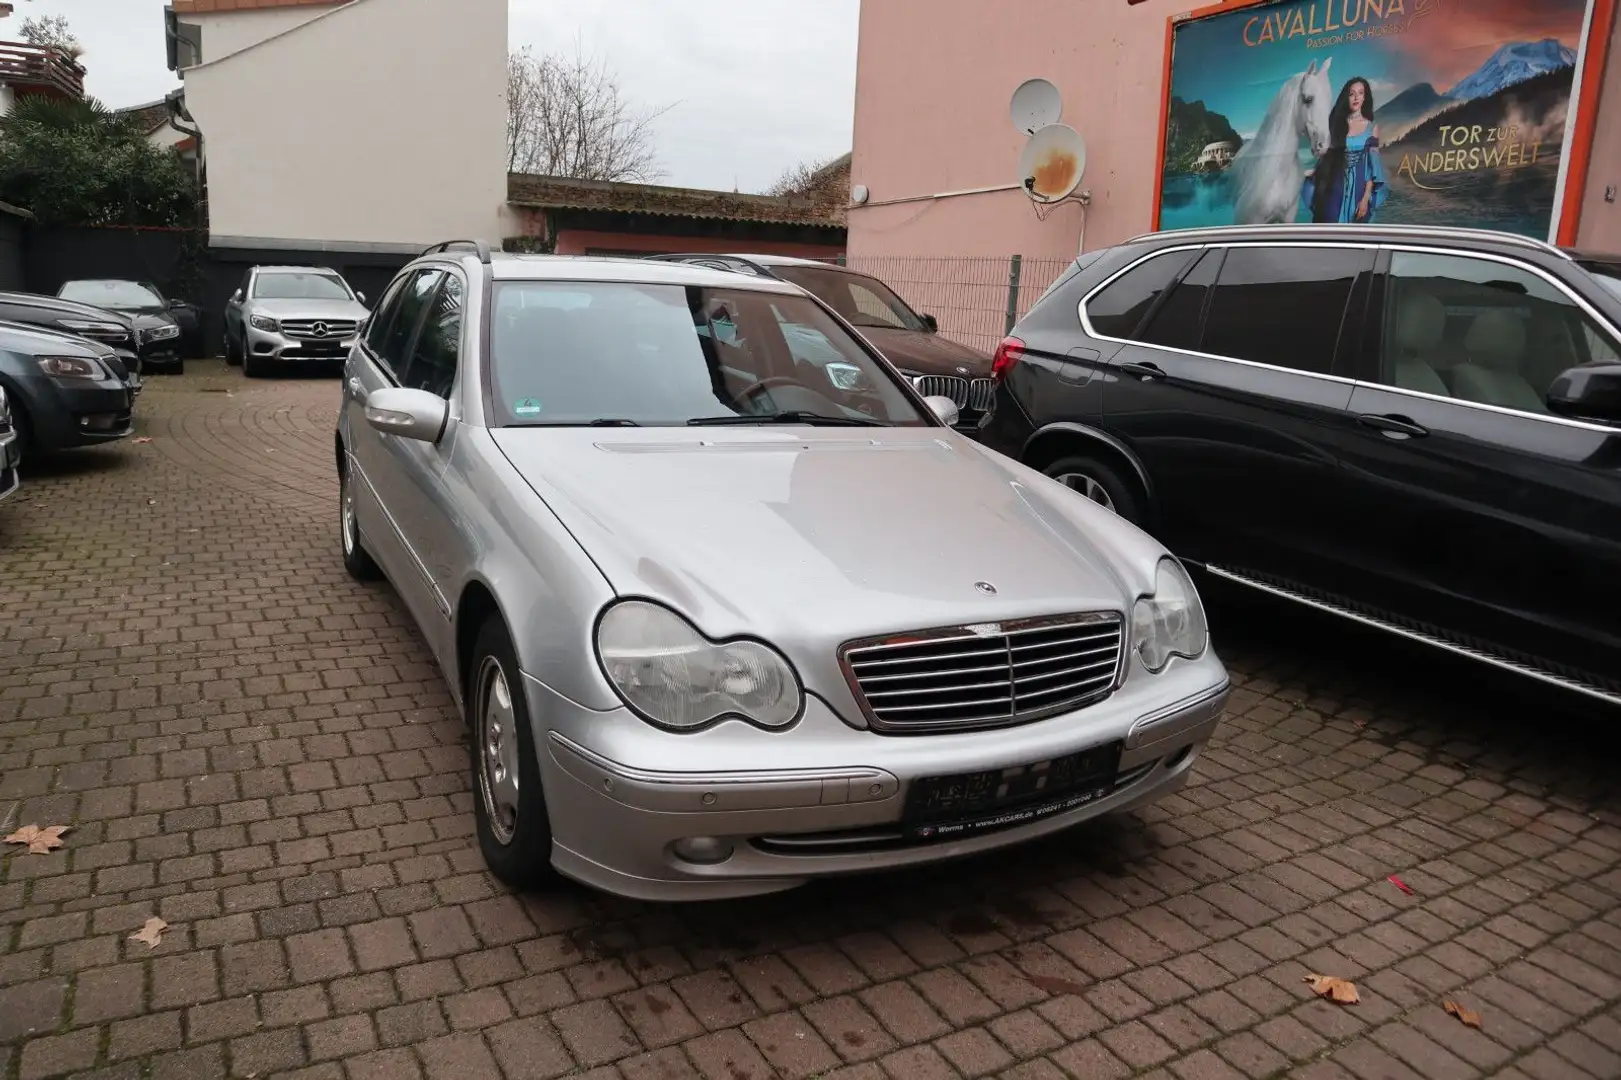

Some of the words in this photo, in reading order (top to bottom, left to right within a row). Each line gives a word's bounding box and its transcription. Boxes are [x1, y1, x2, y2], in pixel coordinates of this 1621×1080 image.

[1243, 0, 1405, 47] CAVALLUNA
[1346, 30, 1365, 42] FOR
[1439, 125, 1482, 146] TOR
[1487, 126, 1518, 142] ZUR
[1398, 142, 1541, 175] ANDERSWELT
[524, 398, 533, 408] 4
[938, 824, 964, 833] Worms
